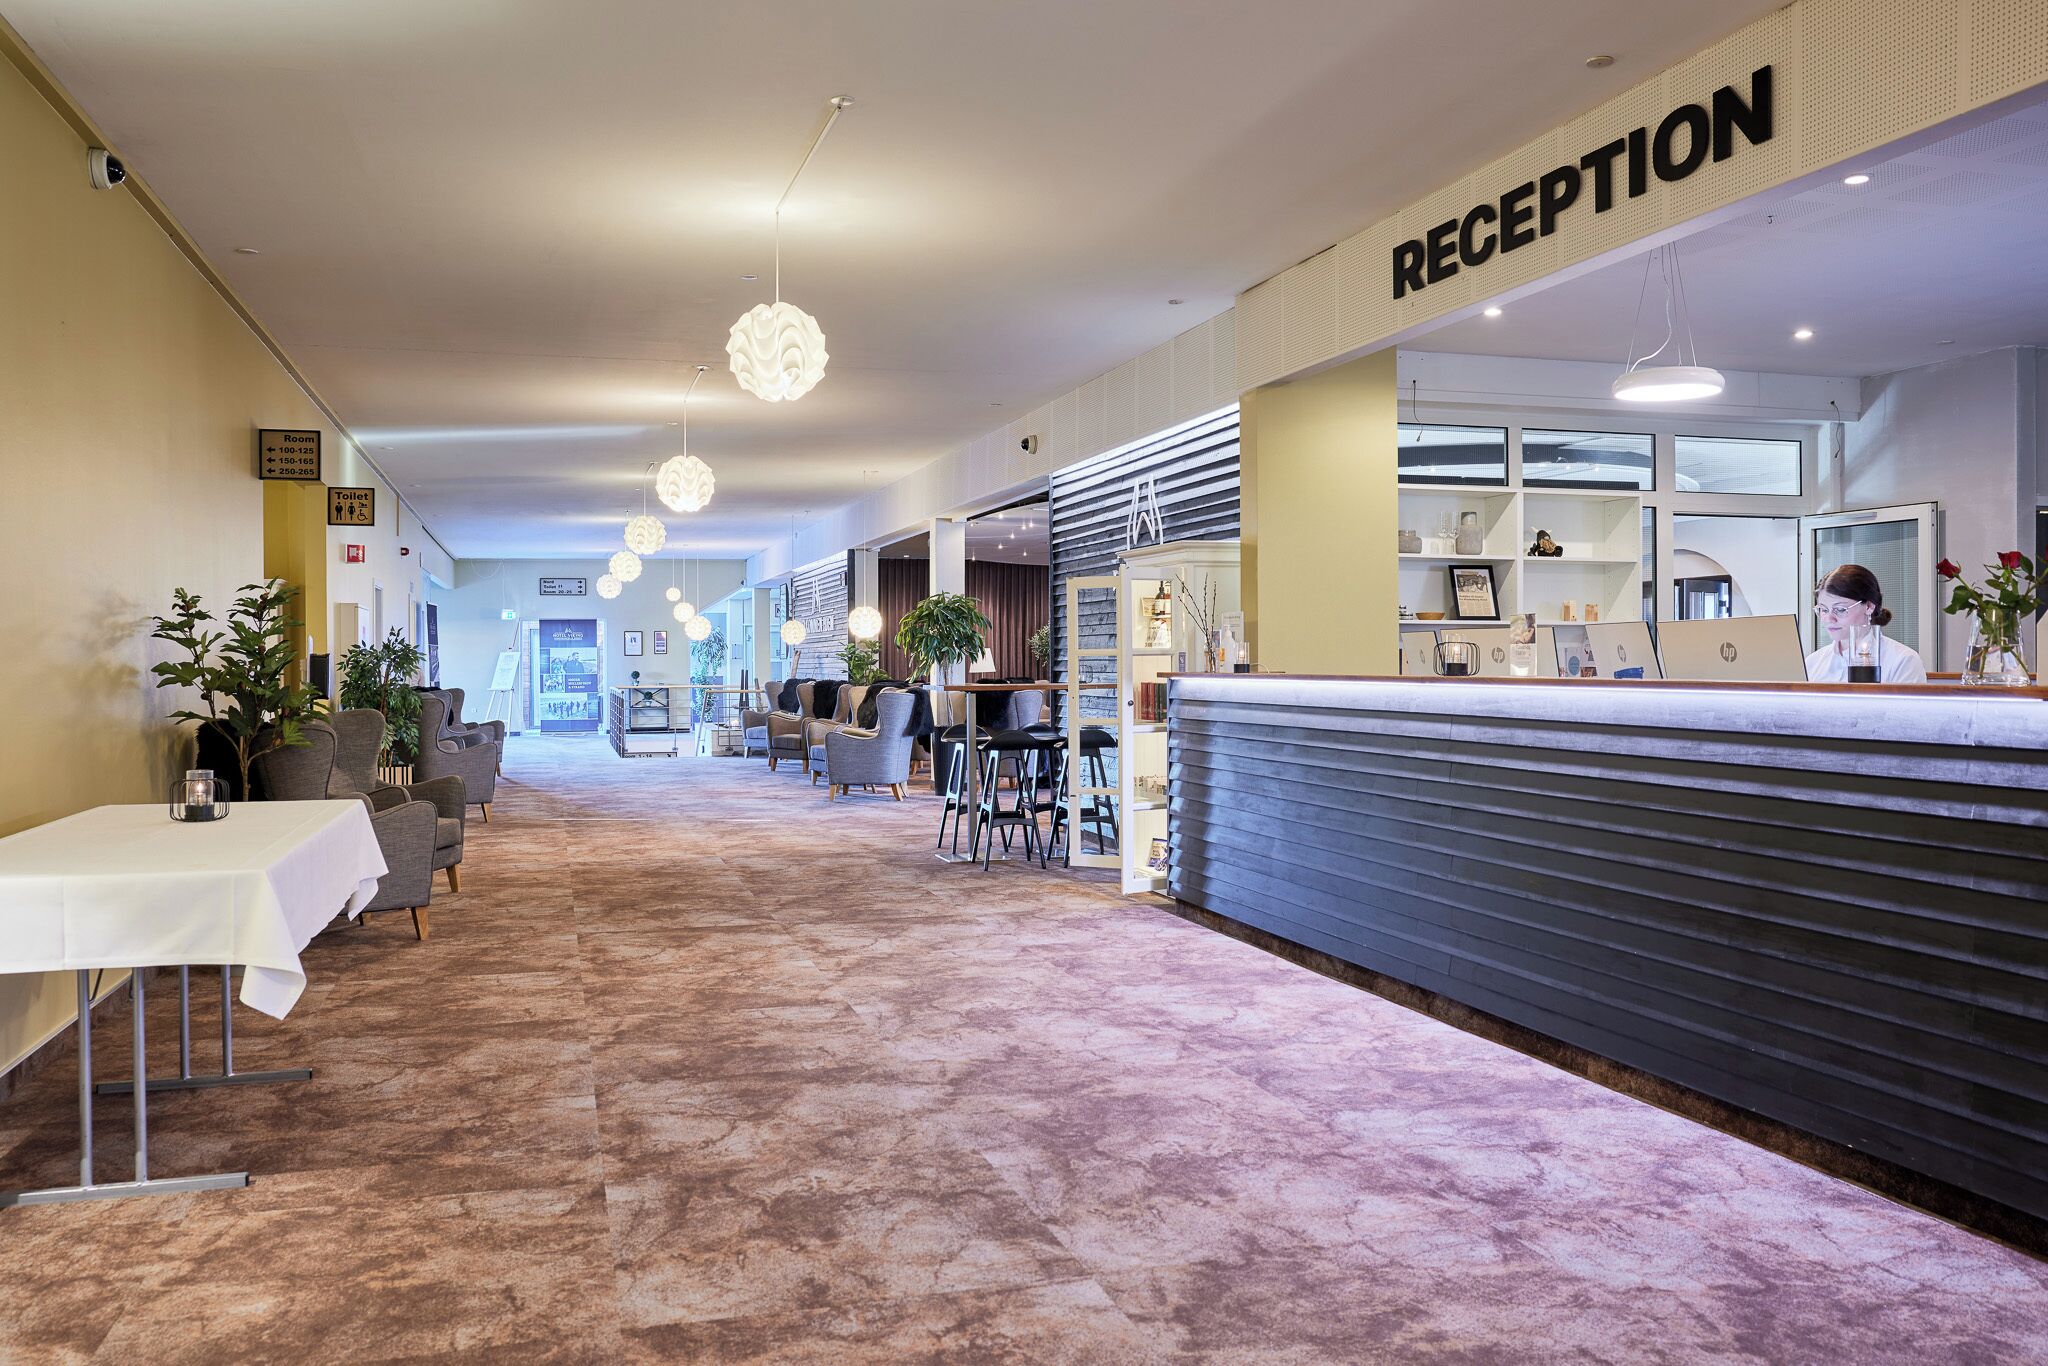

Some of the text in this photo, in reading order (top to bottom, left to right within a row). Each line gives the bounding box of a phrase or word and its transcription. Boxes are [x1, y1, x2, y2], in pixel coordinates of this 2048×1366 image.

[1392, 64, 1773, 300] RECEPTION
[284, 434, 315, 443] Room
[335, 492, 369, 501] Toilet
[1492, 647, 1505, 663] hp
[1720, 642, 1737, 663] hp
